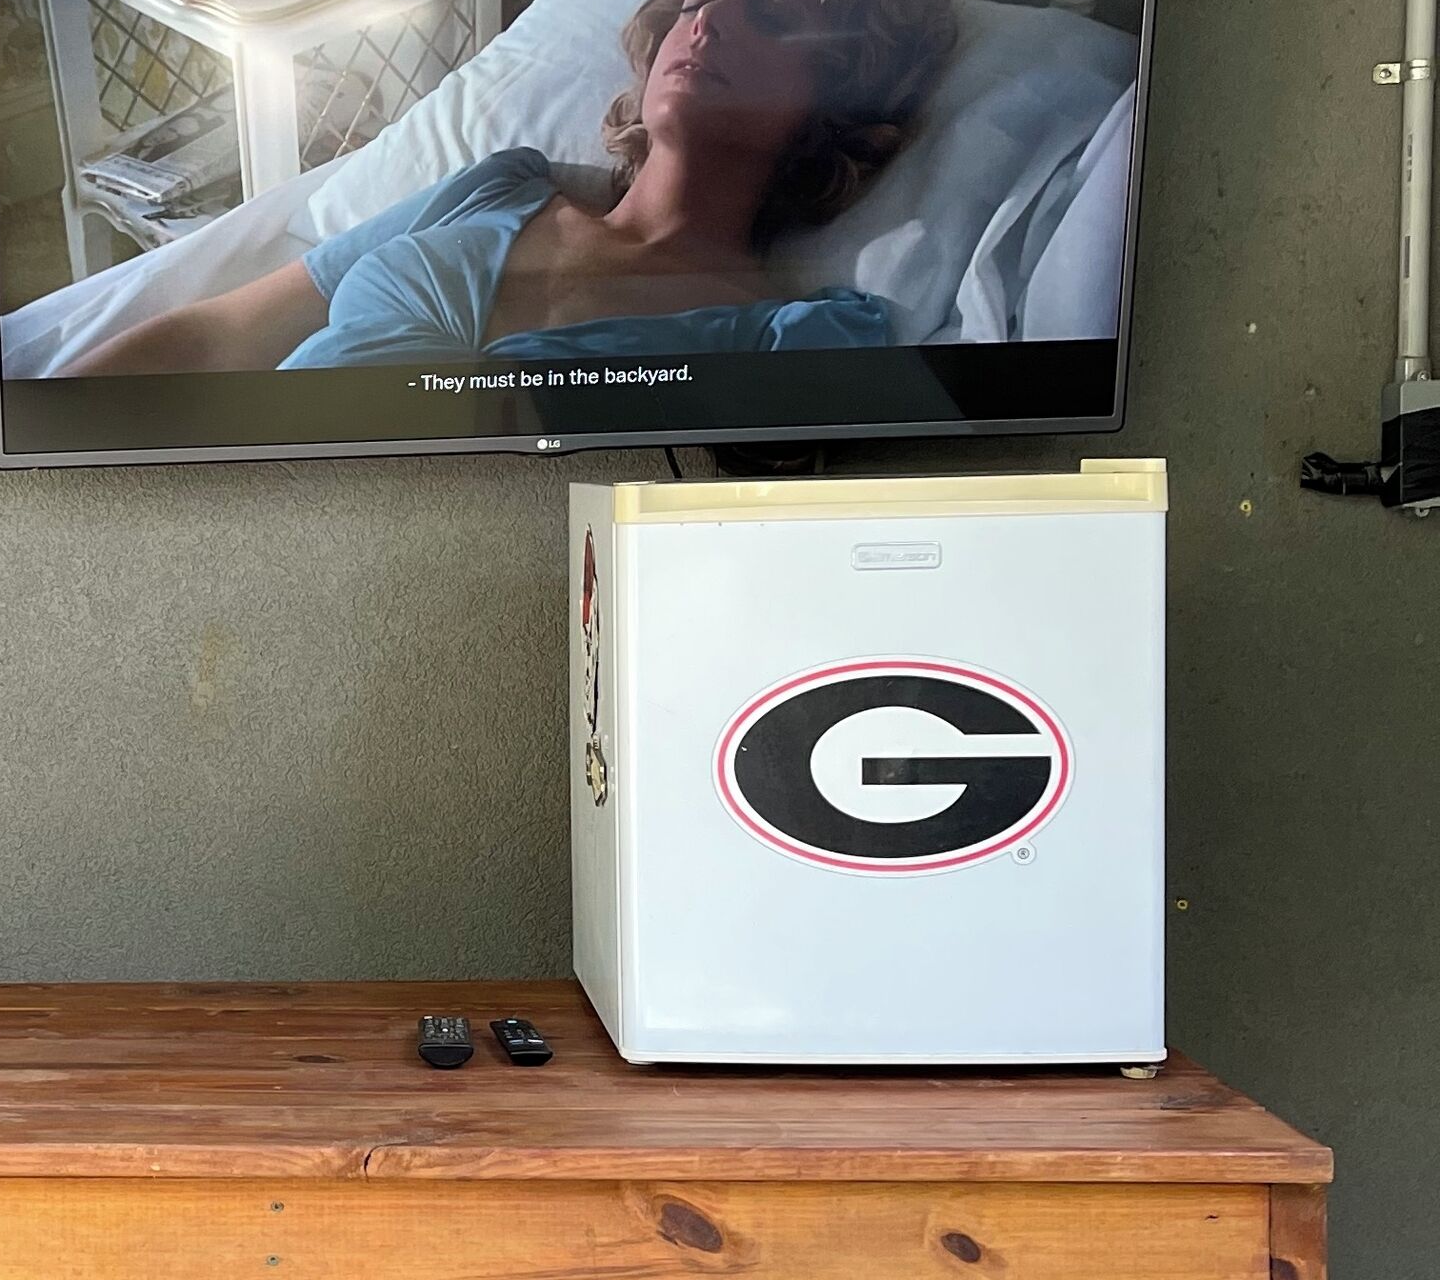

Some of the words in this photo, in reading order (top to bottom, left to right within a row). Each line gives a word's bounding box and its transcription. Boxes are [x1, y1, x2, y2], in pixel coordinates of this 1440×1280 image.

[420, 373, 466, 393] They
[469, 372, 516, 389] must
[520, 370, 544, 387] be
[548, 369, 564, 386] in
[569, 368, 600, 385] the
[604, 364, 693, 388] backyard.
[548, 439, 561, 449] LG
[734, 675, 1052, 859] G
